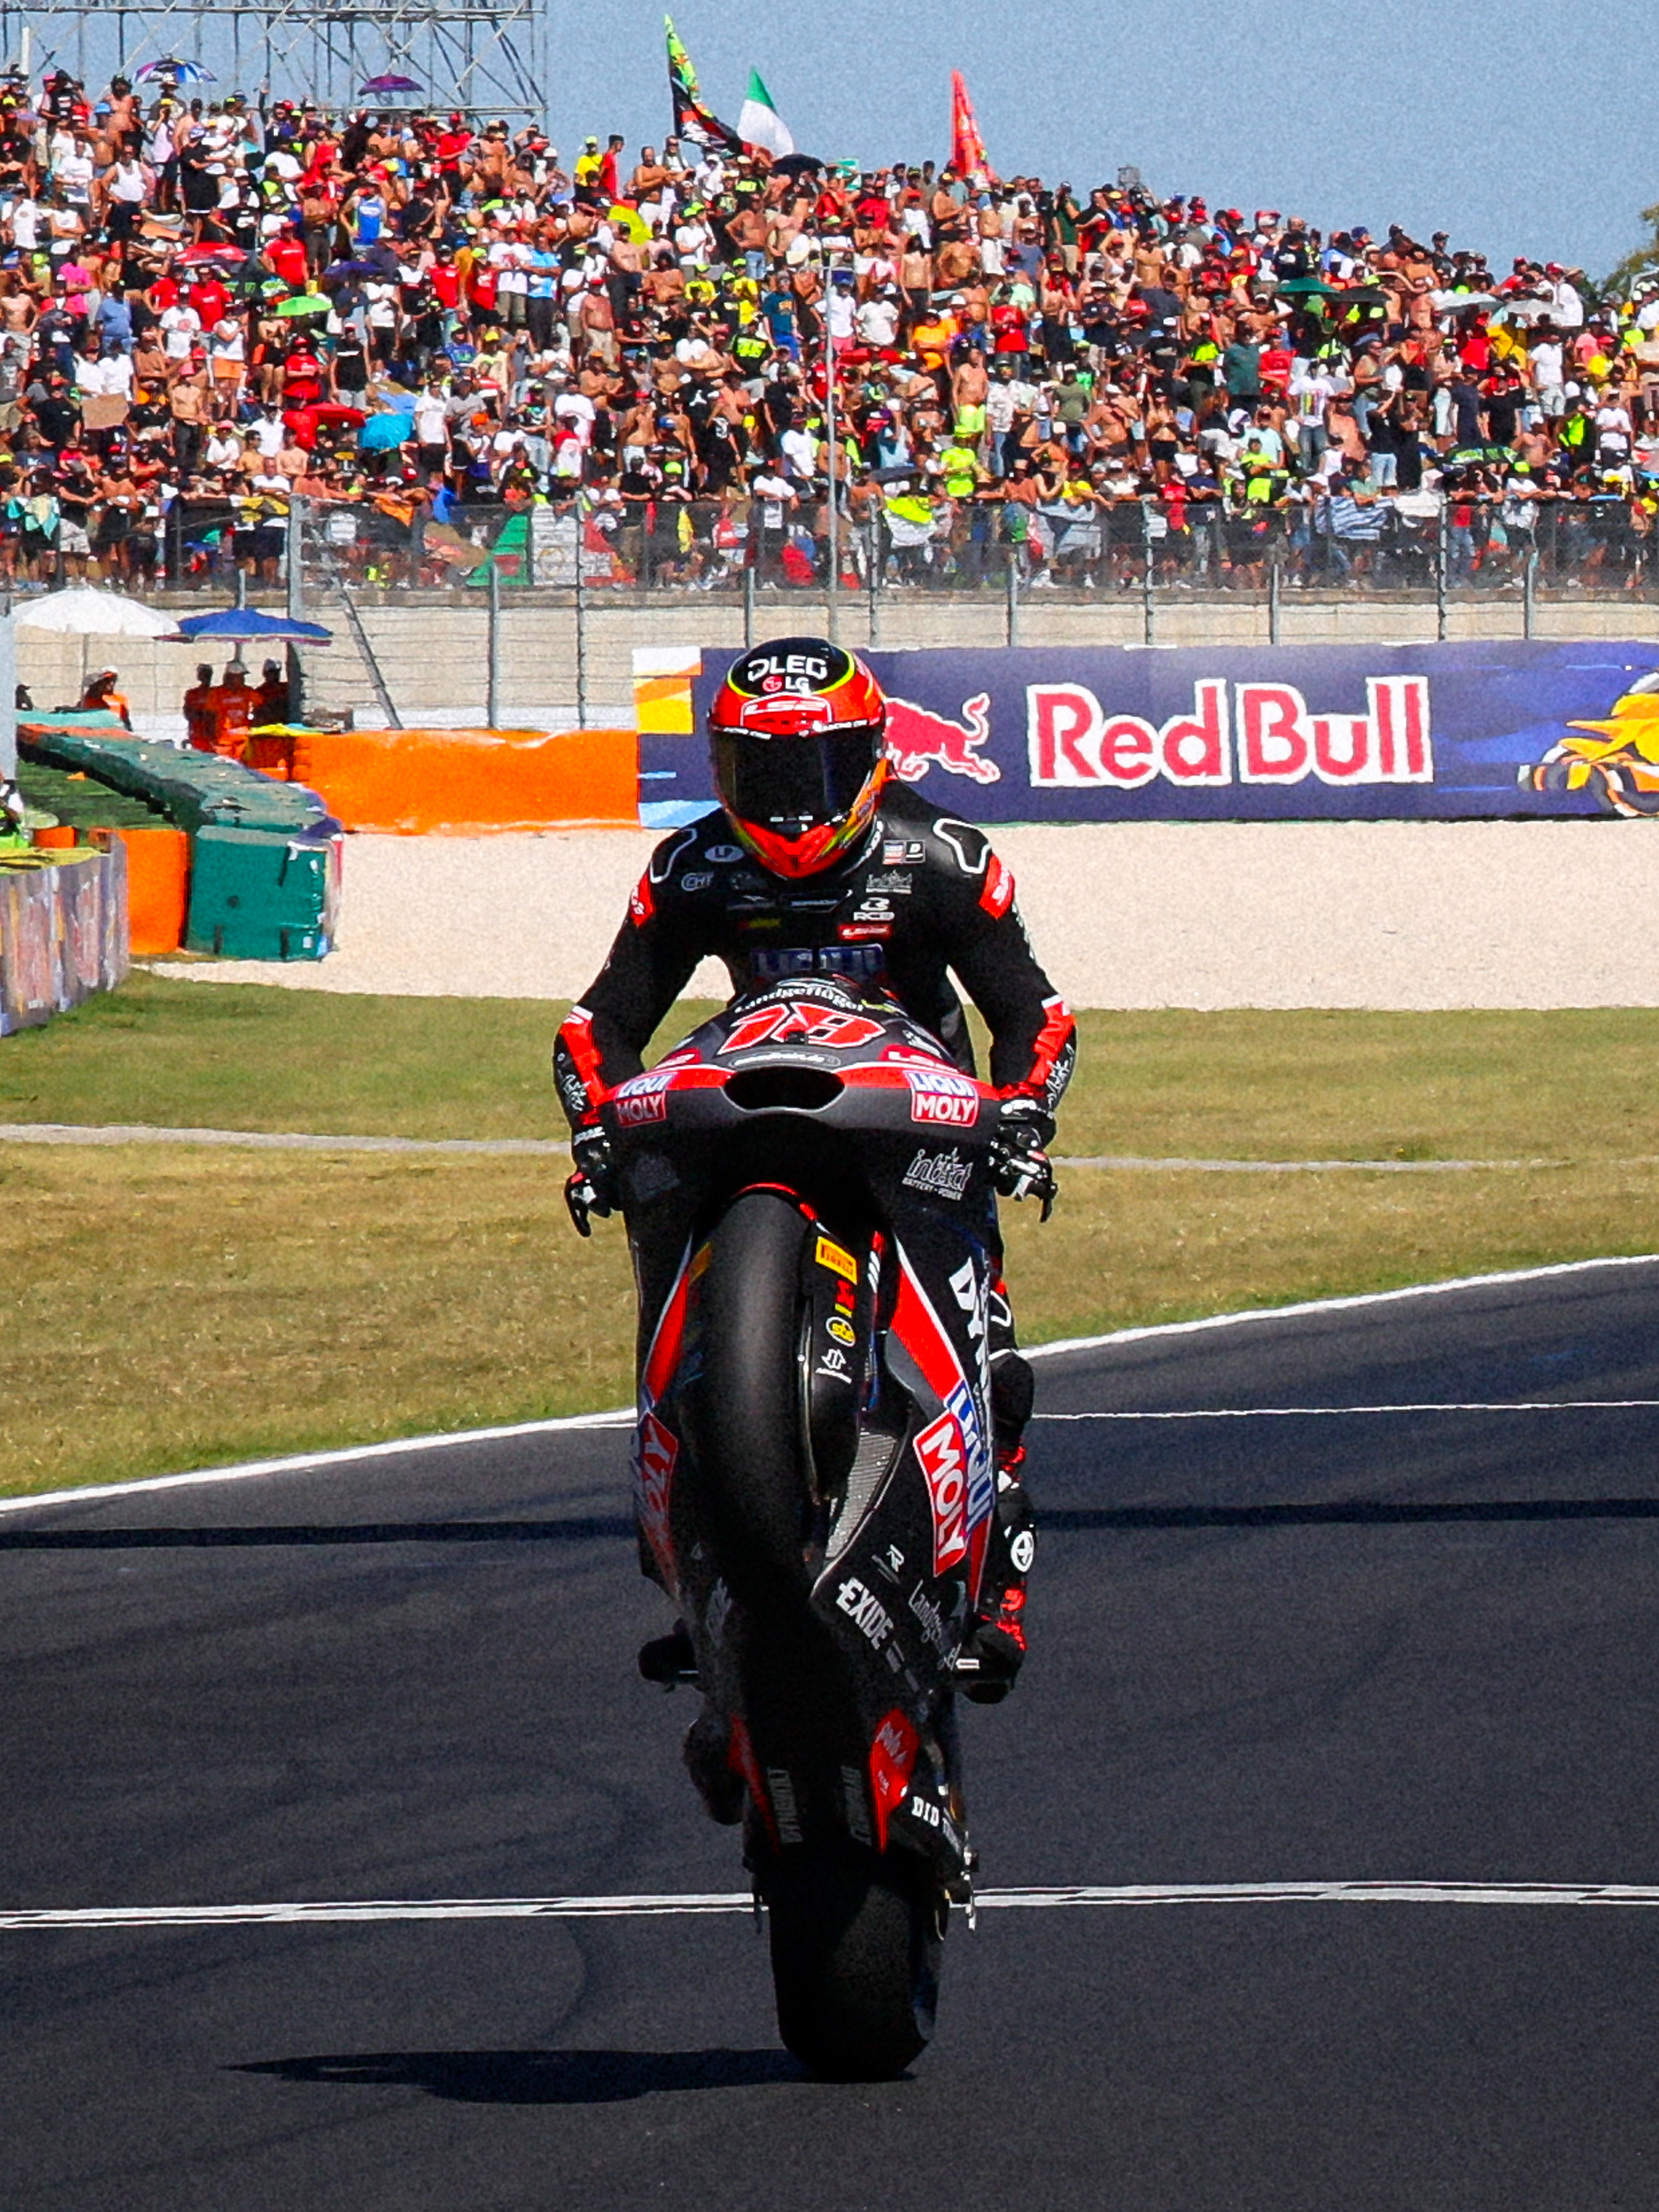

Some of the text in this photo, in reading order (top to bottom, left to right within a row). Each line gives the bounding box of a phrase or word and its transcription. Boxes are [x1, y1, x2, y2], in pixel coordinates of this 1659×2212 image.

[785, 675, 810, 691] LG
[1033, 680, 1428, 781] Red Bull
[618, 1073, 673, 1099] LIQUI
[907, 1071, 975, 1097] LIQUI
[615, 1095, 663, 1124] MOLY
[916, 1095, 975, 1122] MOLY
[951, 1387, 993, 1533] LIQUI
[920, 1421, 965, 1561] MOLY
[836, 1577, 895, 1651] EXIDE
[911, 1795, 940, 1828] DID
